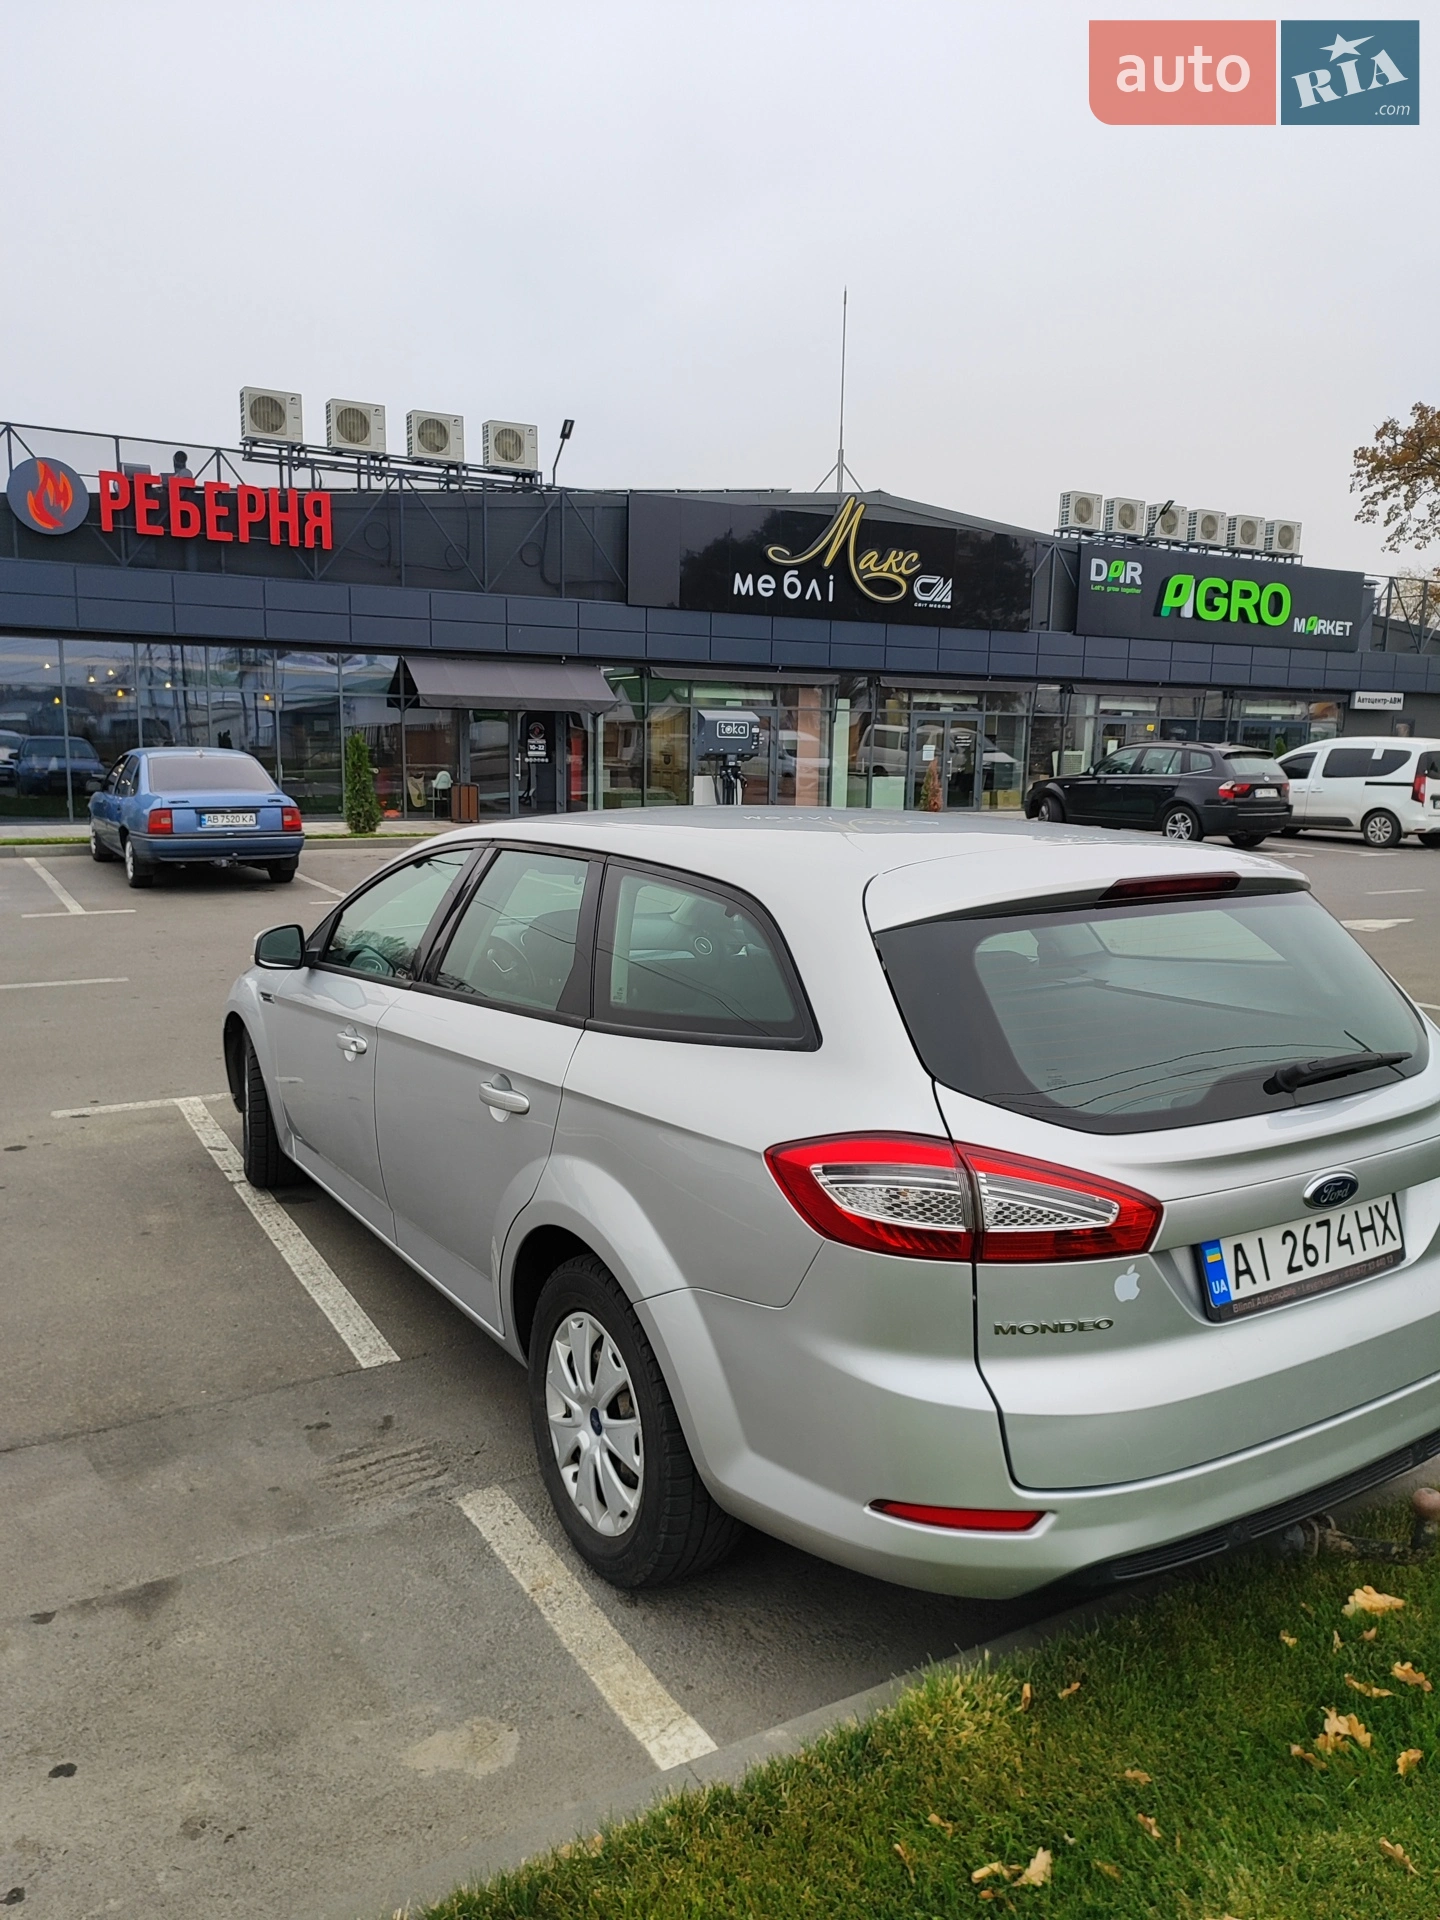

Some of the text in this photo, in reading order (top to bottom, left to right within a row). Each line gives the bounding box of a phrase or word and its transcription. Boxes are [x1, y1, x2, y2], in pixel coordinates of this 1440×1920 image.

[98, 470, 333, 550] РЕБЕРНЯ
[765, 495, 922, 603] Макс
[1090, 558, 1143, 585] DAR
[733, 569, 835, 603] меблі
[1160, 573, 1292, 627] AGRO
[1293, 616, 1353, 636] MARKET
[207, 815, 255, 823] AB 7520 KA
[1320, 1181, 1350, 1203] Ford
[1233, 1201, 1397, 1290] AI 2674 HX
[1211, 1279, 1228, 1294] UA
[994, 1317, 1113, 1335] MONDEO
